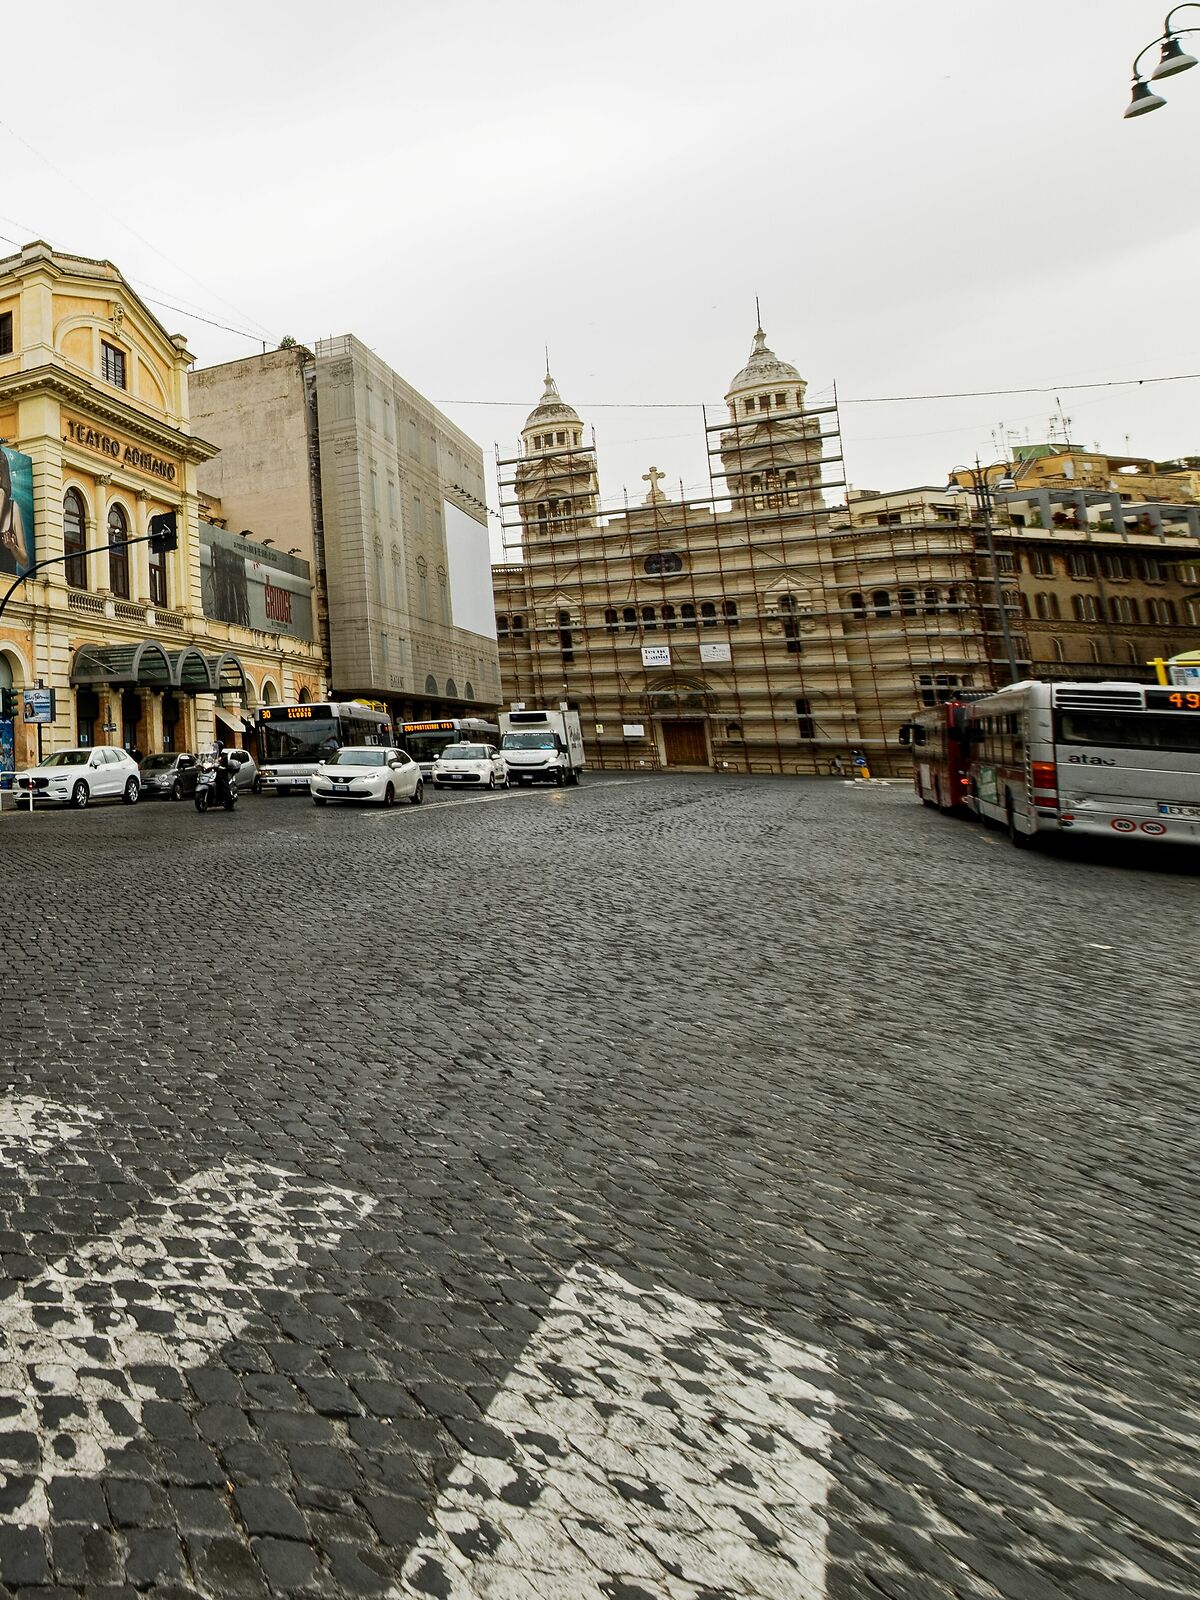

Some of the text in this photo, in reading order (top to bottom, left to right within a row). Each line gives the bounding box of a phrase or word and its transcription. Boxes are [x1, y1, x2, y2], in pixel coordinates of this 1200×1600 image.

[68, 420, 176, 481] TEATRO ADRIANO
[261, 710, 271, 719] 30
